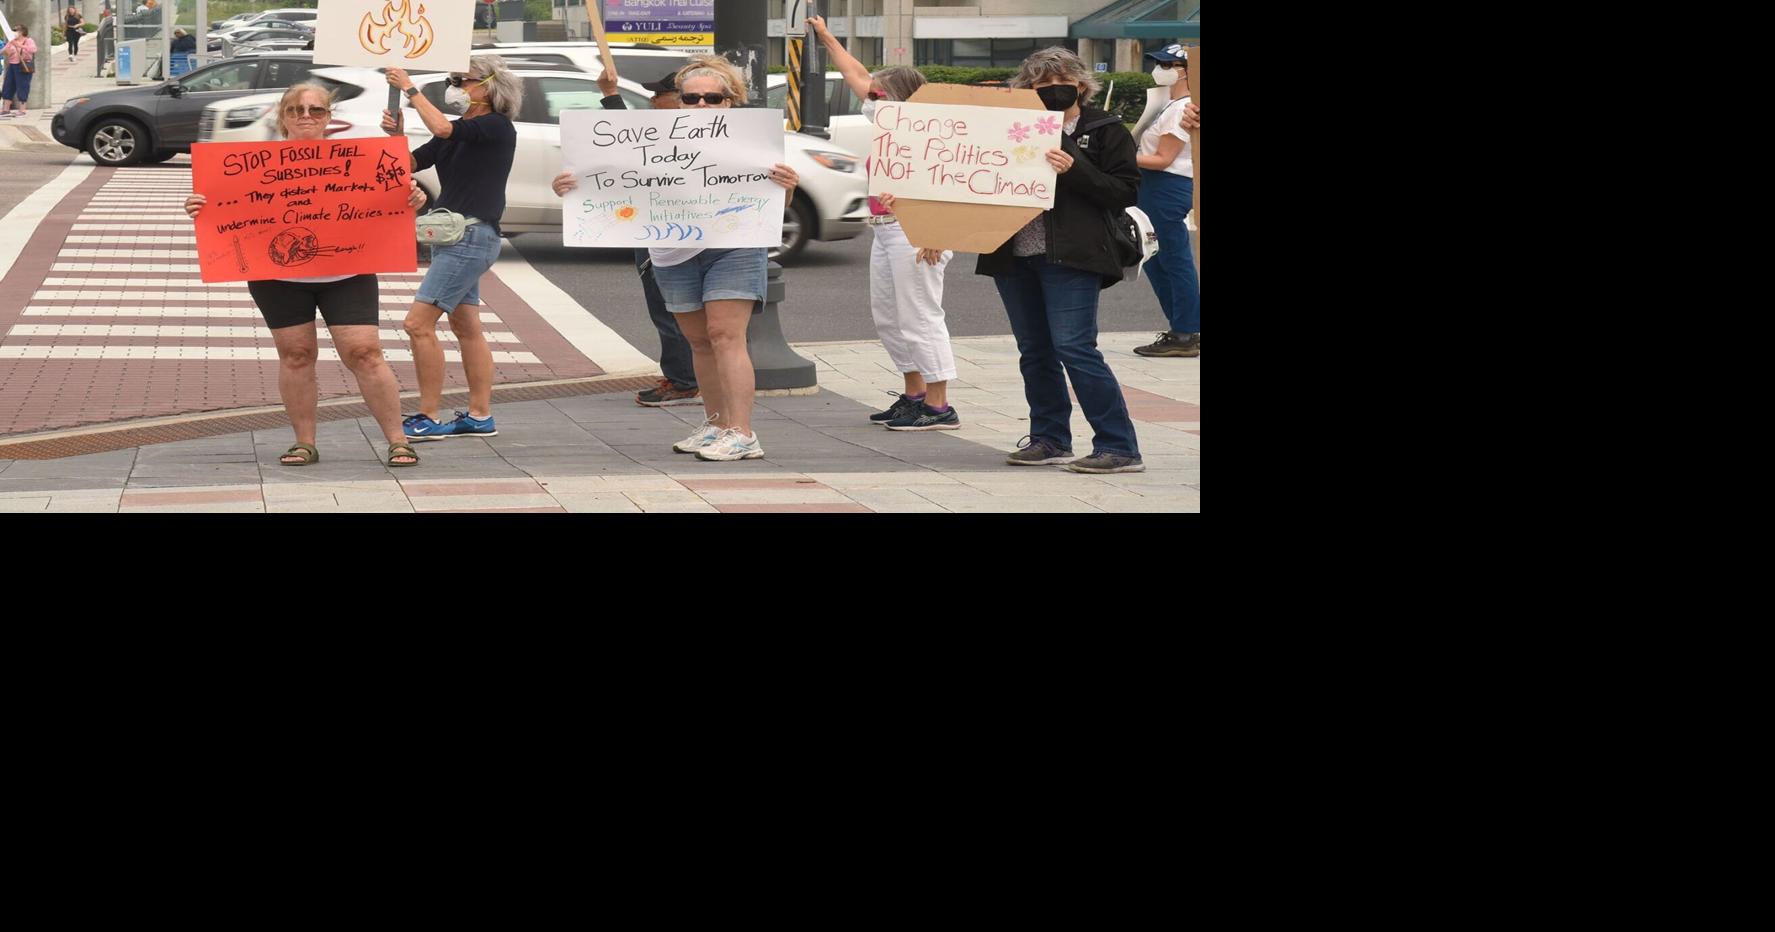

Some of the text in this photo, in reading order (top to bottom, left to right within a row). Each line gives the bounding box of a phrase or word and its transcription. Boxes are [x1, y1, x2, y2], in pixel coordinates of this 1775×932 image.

[635, 22, 662, 31] YULI
[592, 114, 729, 147] Save Earth
[875, 104, 969, 140] Change
[223, 143, 367, 177] STOP FOSSIL FUEL
[633, 144, 702, 170] Today
[873, 131, 1009, 167] The Politics
[585, 171, 616, 191] To
[620, 170, 686, 189] Survive
[927, 163, 967, 186] The
[967, 169, 1050, 200] Climate
[245, 191, 276, 204] They
[280, 185, 317, 198] distort
[286, 198, 312, 208] and
[582, 191, 770, 214] Support Renewable Energy
[216, 215, 277, 234] undermine
[282, 207, 332, 225] Climate
[336, 202, 384, 222] Policies
[649, 209, 713, 223] Initiatives
